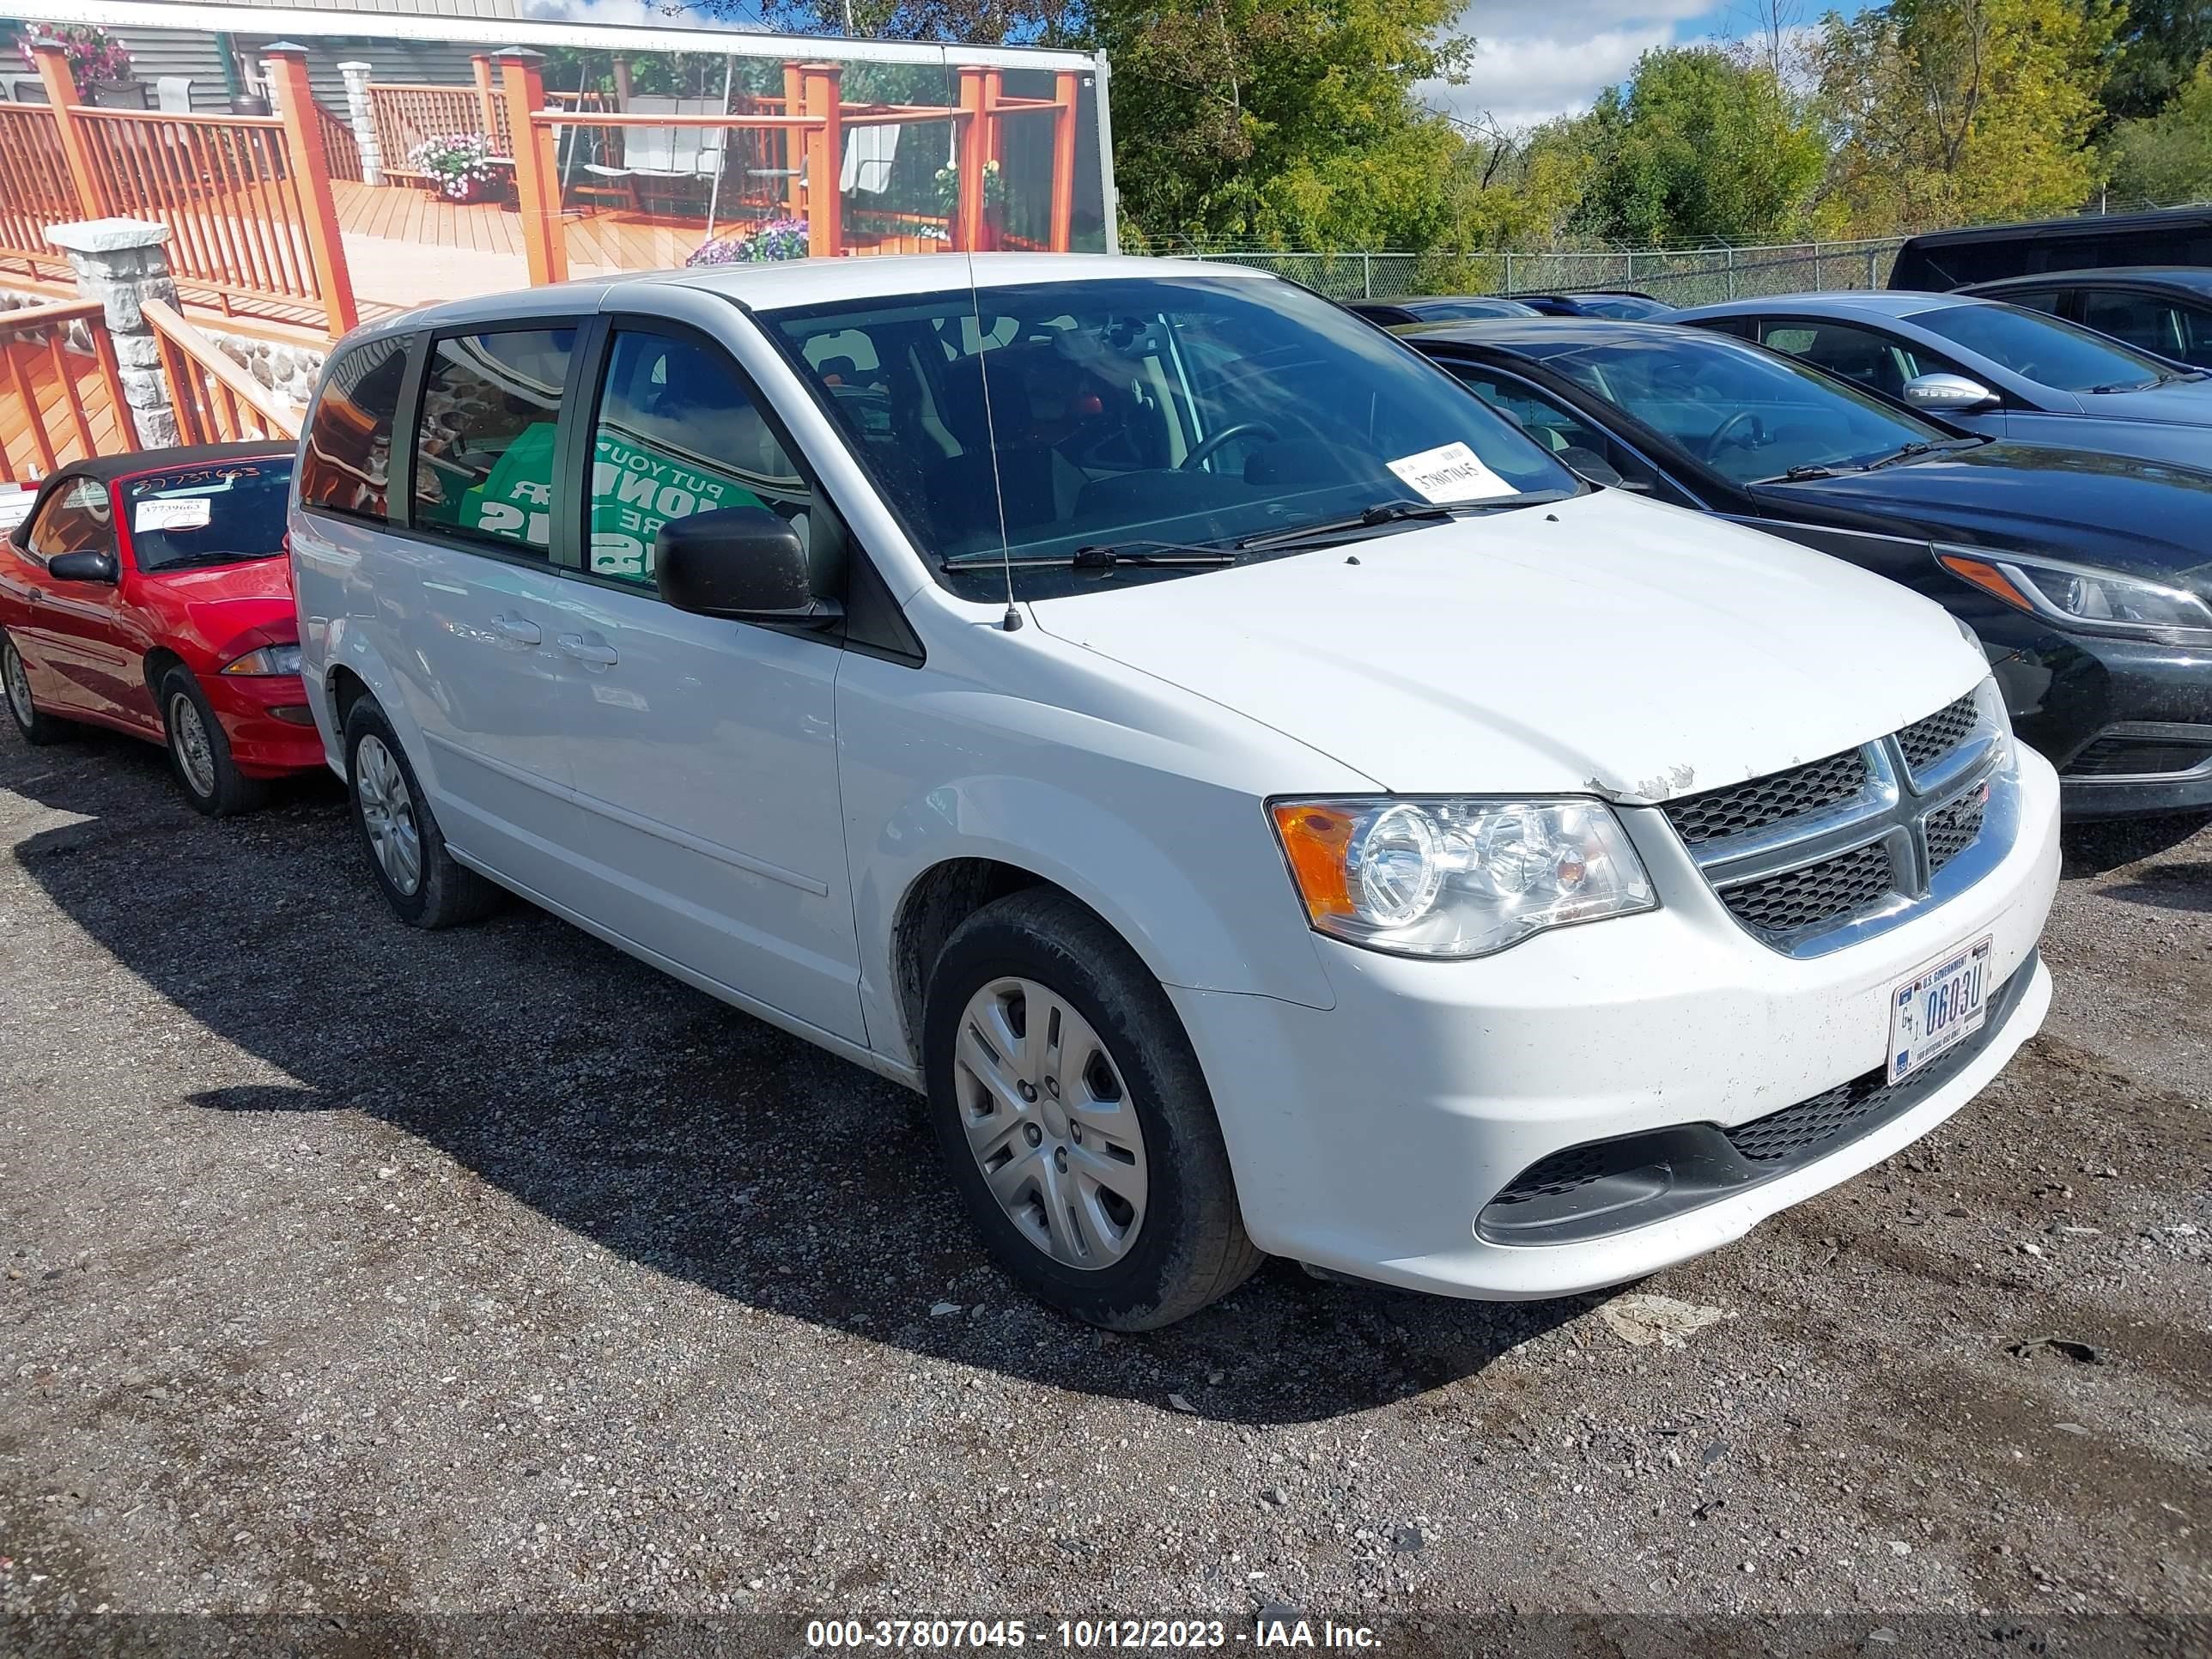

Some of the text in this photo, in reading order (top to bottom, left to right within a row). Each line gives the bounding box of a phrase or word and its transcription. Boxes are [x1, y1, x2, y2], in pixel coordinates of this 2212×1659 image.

[1415, 463, 1480, 489] 37807045
[1923, 954, 1967, 989] U.S. GOVERNMENT
